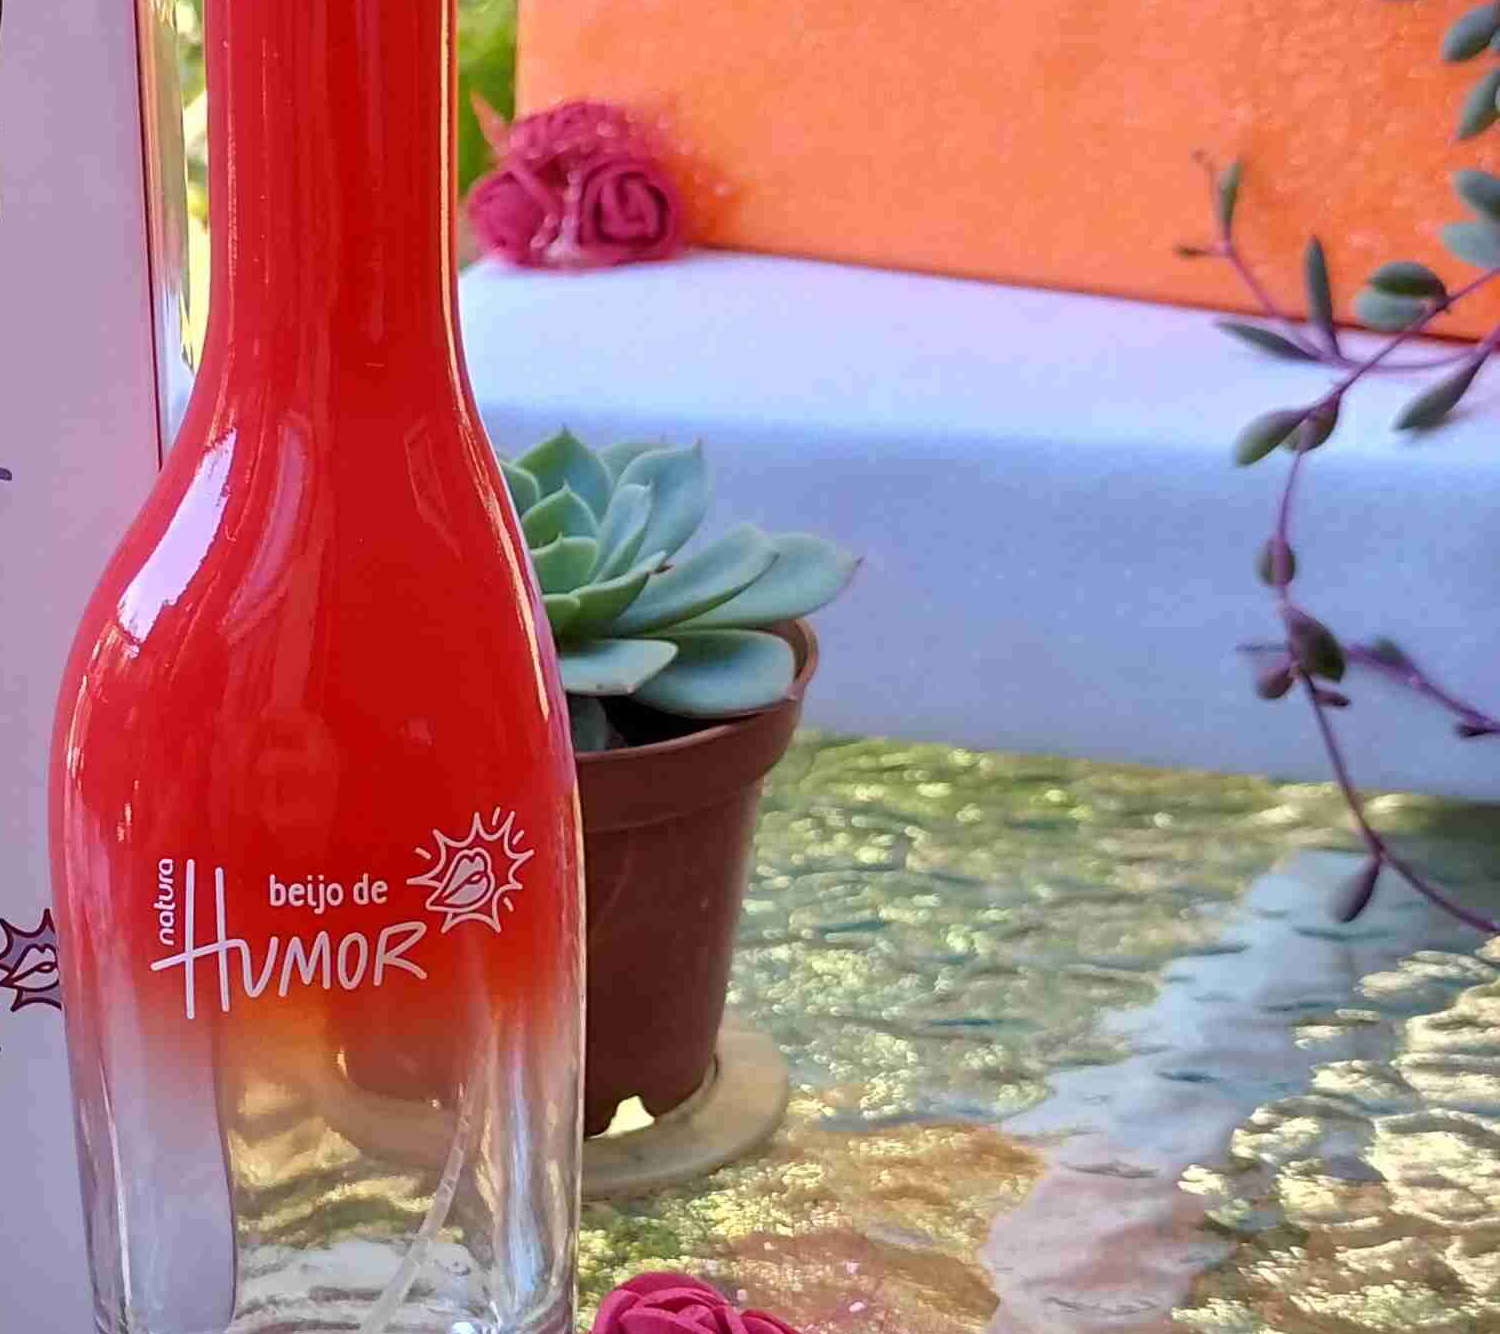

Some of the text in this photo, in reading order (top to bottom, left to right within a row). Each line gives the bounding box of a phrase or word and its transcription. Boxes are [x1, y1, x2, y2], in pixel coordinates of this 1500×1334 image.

[157, 858, 175, 946] natura
[269, 874, 388, 914] beijo de
